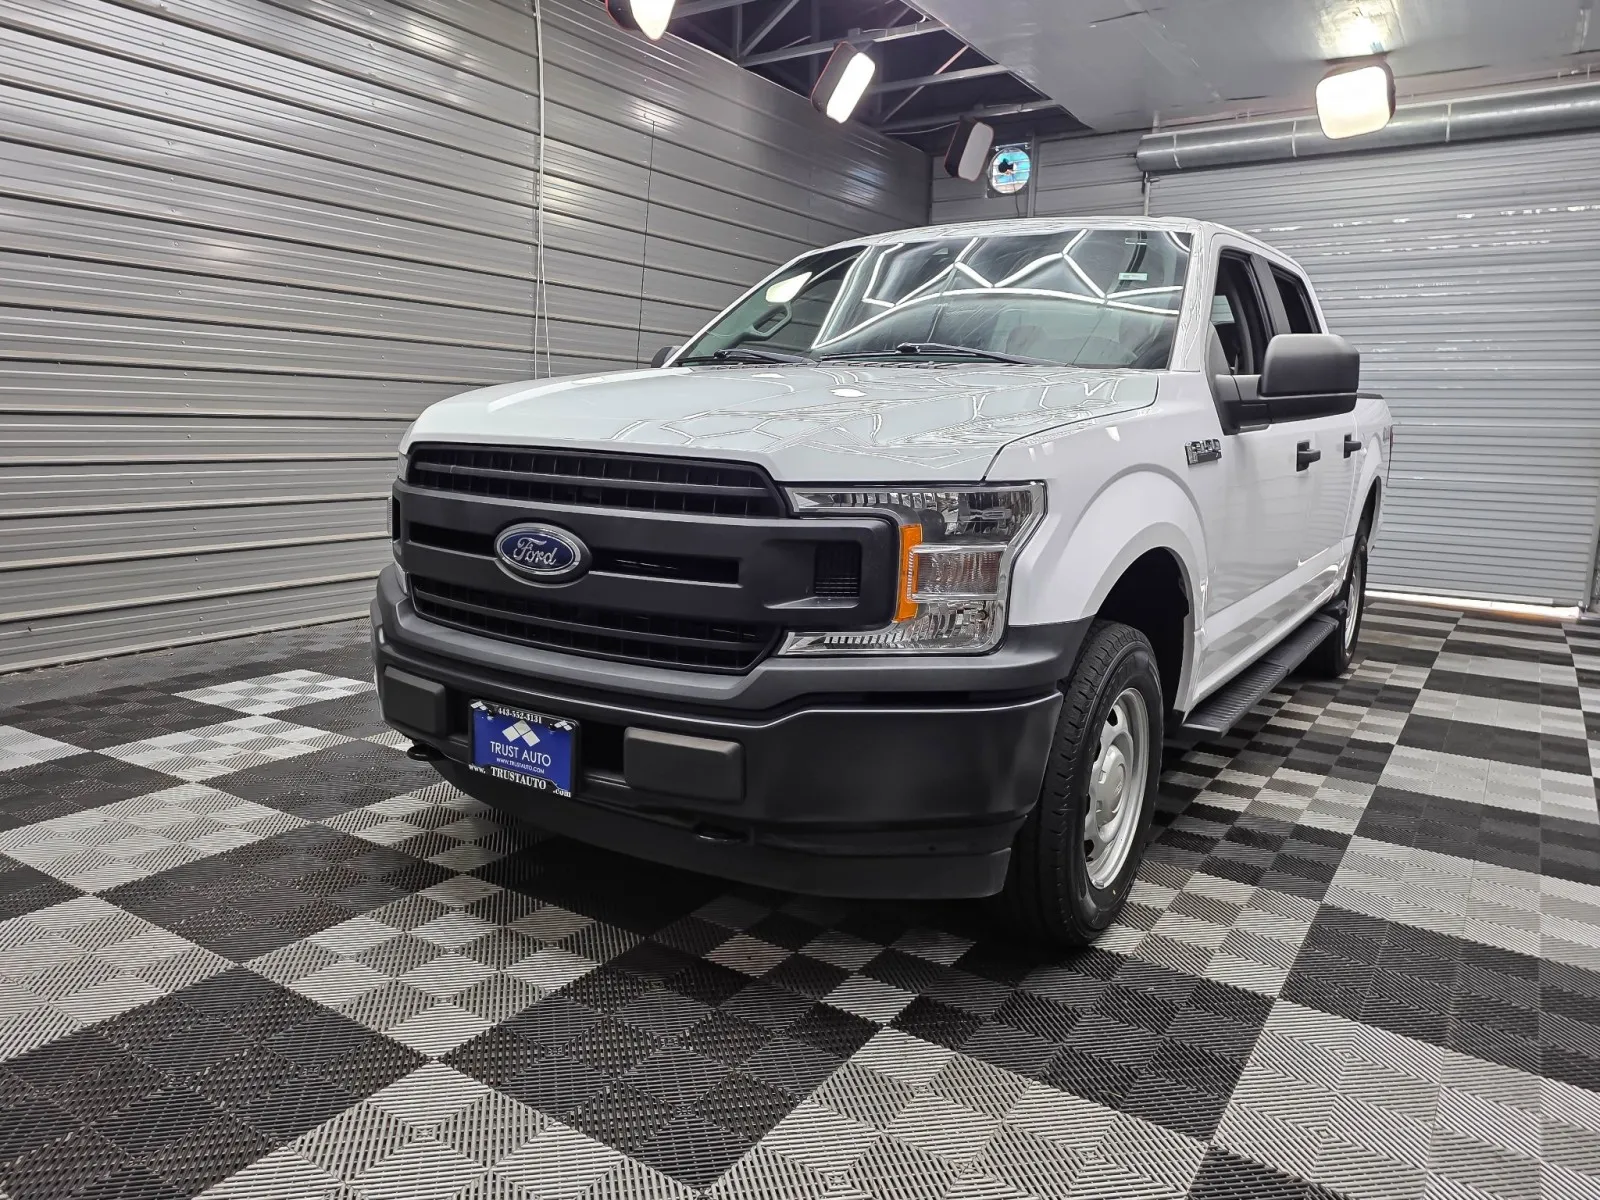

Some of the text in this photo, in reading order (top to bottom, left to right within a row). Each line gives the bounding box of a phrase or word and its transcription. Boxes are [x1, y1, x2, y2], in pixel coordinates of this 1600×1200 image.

[513, 537, 558, 565] Ford
[498, 708, 542, 724] 443-552-3131
[490, 741, 551, 767] TRUST AUTO
[490, 766, 547, 790] TRUSTAUTO
[552, 788, 571, 798] .com
